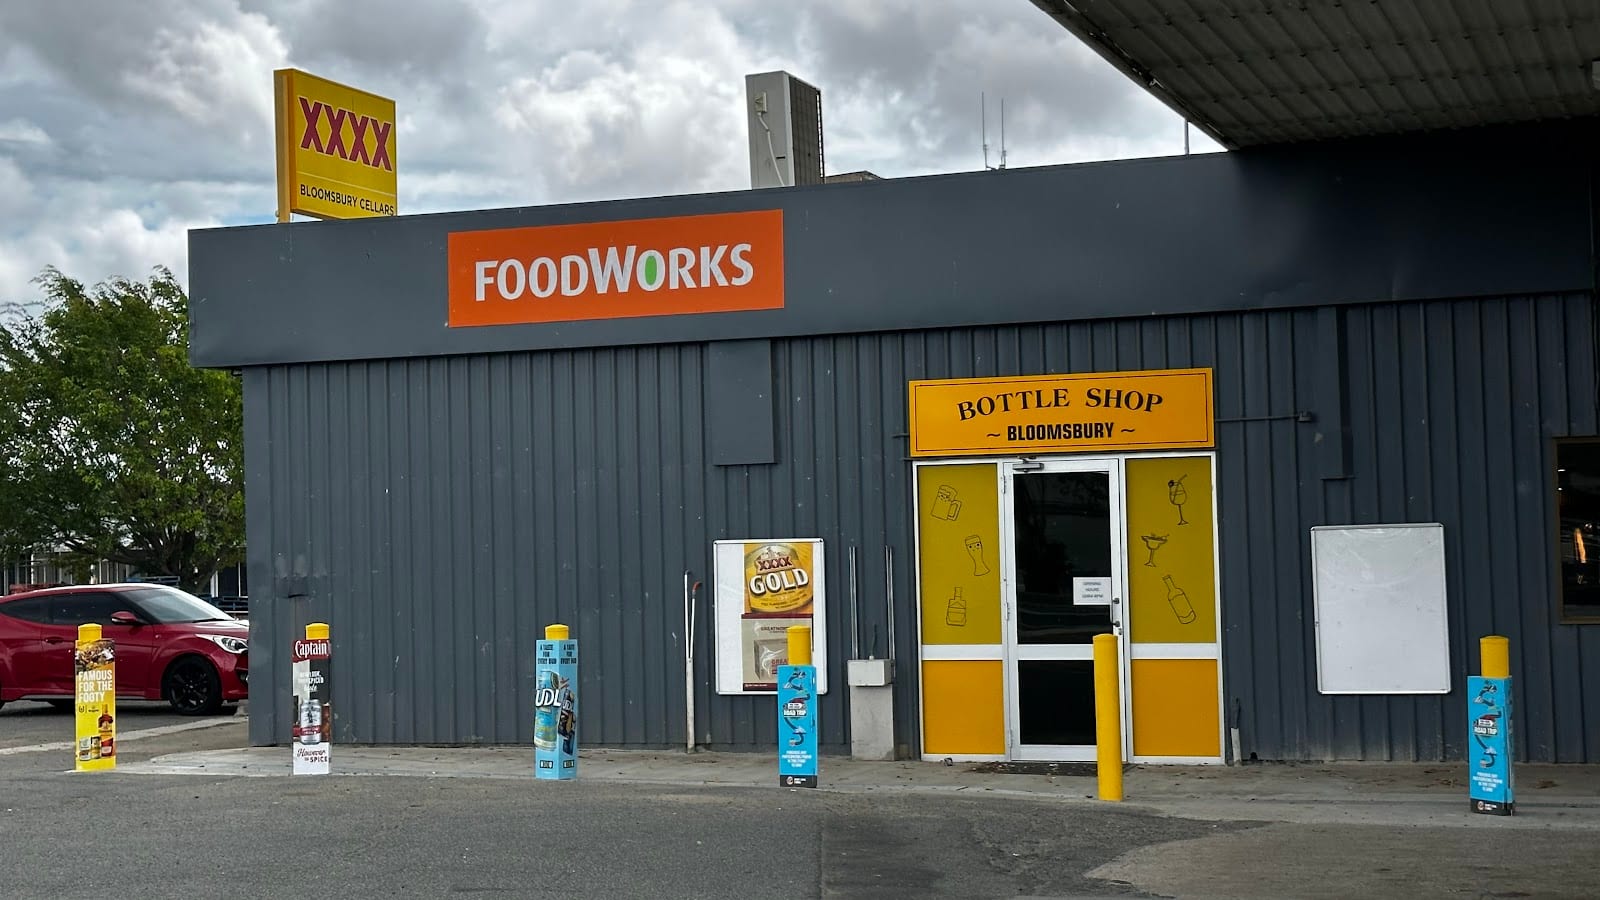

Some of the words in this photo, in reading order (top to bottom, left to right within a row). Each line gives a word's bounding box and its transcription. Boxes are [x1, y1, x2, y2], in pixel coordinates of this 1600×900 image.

[298, 96, 393, 172] XXXX
[300, 183, 358, 209] BLOOMSBURY
[359, 198, 394, 217] CELLARS
[475, 243, 754, 302] FOODWORKS
[957, 388, 1070, 422] BOTTLE
[1085, 387, 1164, 414] SHOP
[1007, 421, 1115, 442] BLOOMSBURY
[756, 556, 793, 571] XXXX
[749, 568, 809, 595] GOLD
[295, 640, 328, 658] Captain
[78, 669, 113, 681] FAMOUS
[78, 681, 95, 692] FOR
[97, 680, 113, 691] THE
[78, 691, 105, 703] FOOTY
[535, 688, 562, 707] UDL
